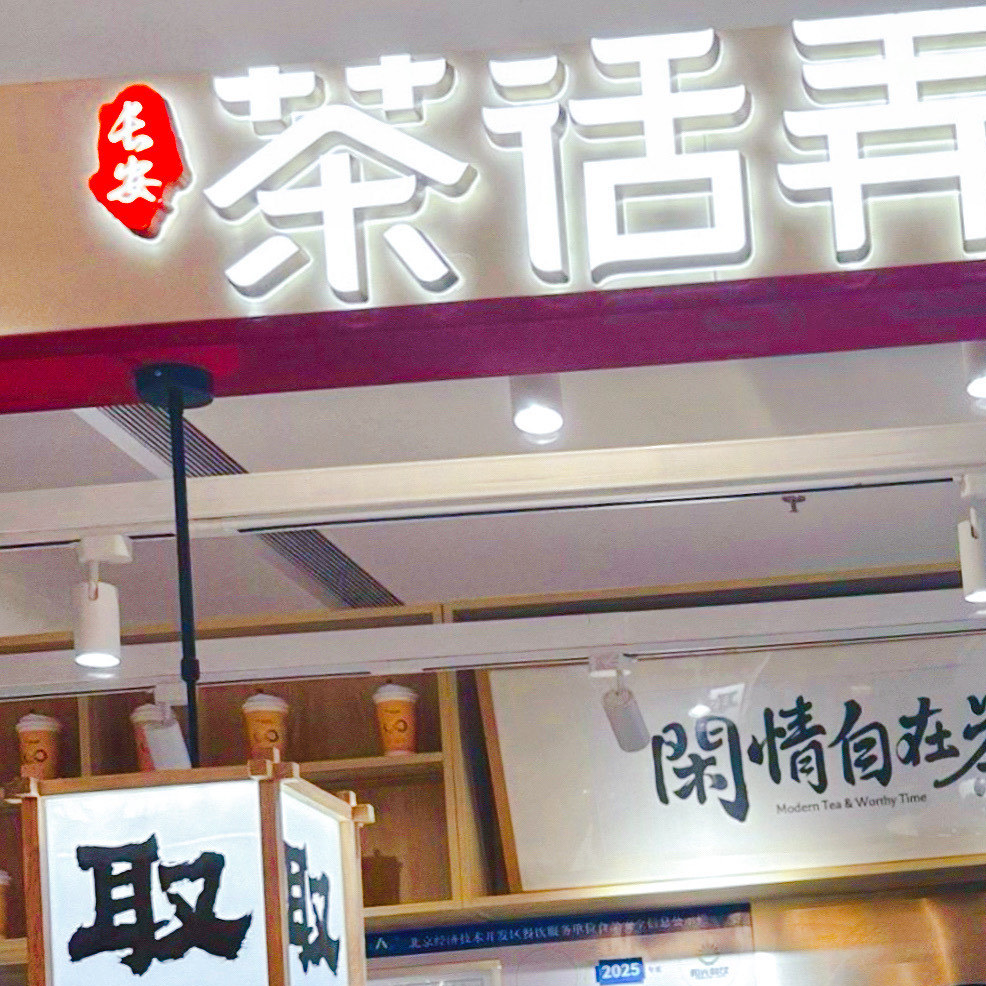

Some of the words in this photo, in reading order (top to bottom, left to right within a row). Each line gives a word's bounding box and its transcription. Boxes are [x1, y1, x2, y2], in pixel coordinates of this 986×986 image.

[106, 100, 163, 204] 长安
[776, 802, 820, 815] Modern
[821, 799, 842, 811] Tea
[844, 797, 853, 809] &
[855, 794, 897, 808] Worthy
[898, 792, 927, 804] Time
[68, 833, 253, 977] 取
[284, 840, 340, 976] 取
[601, 962, 641, 979] 2025
